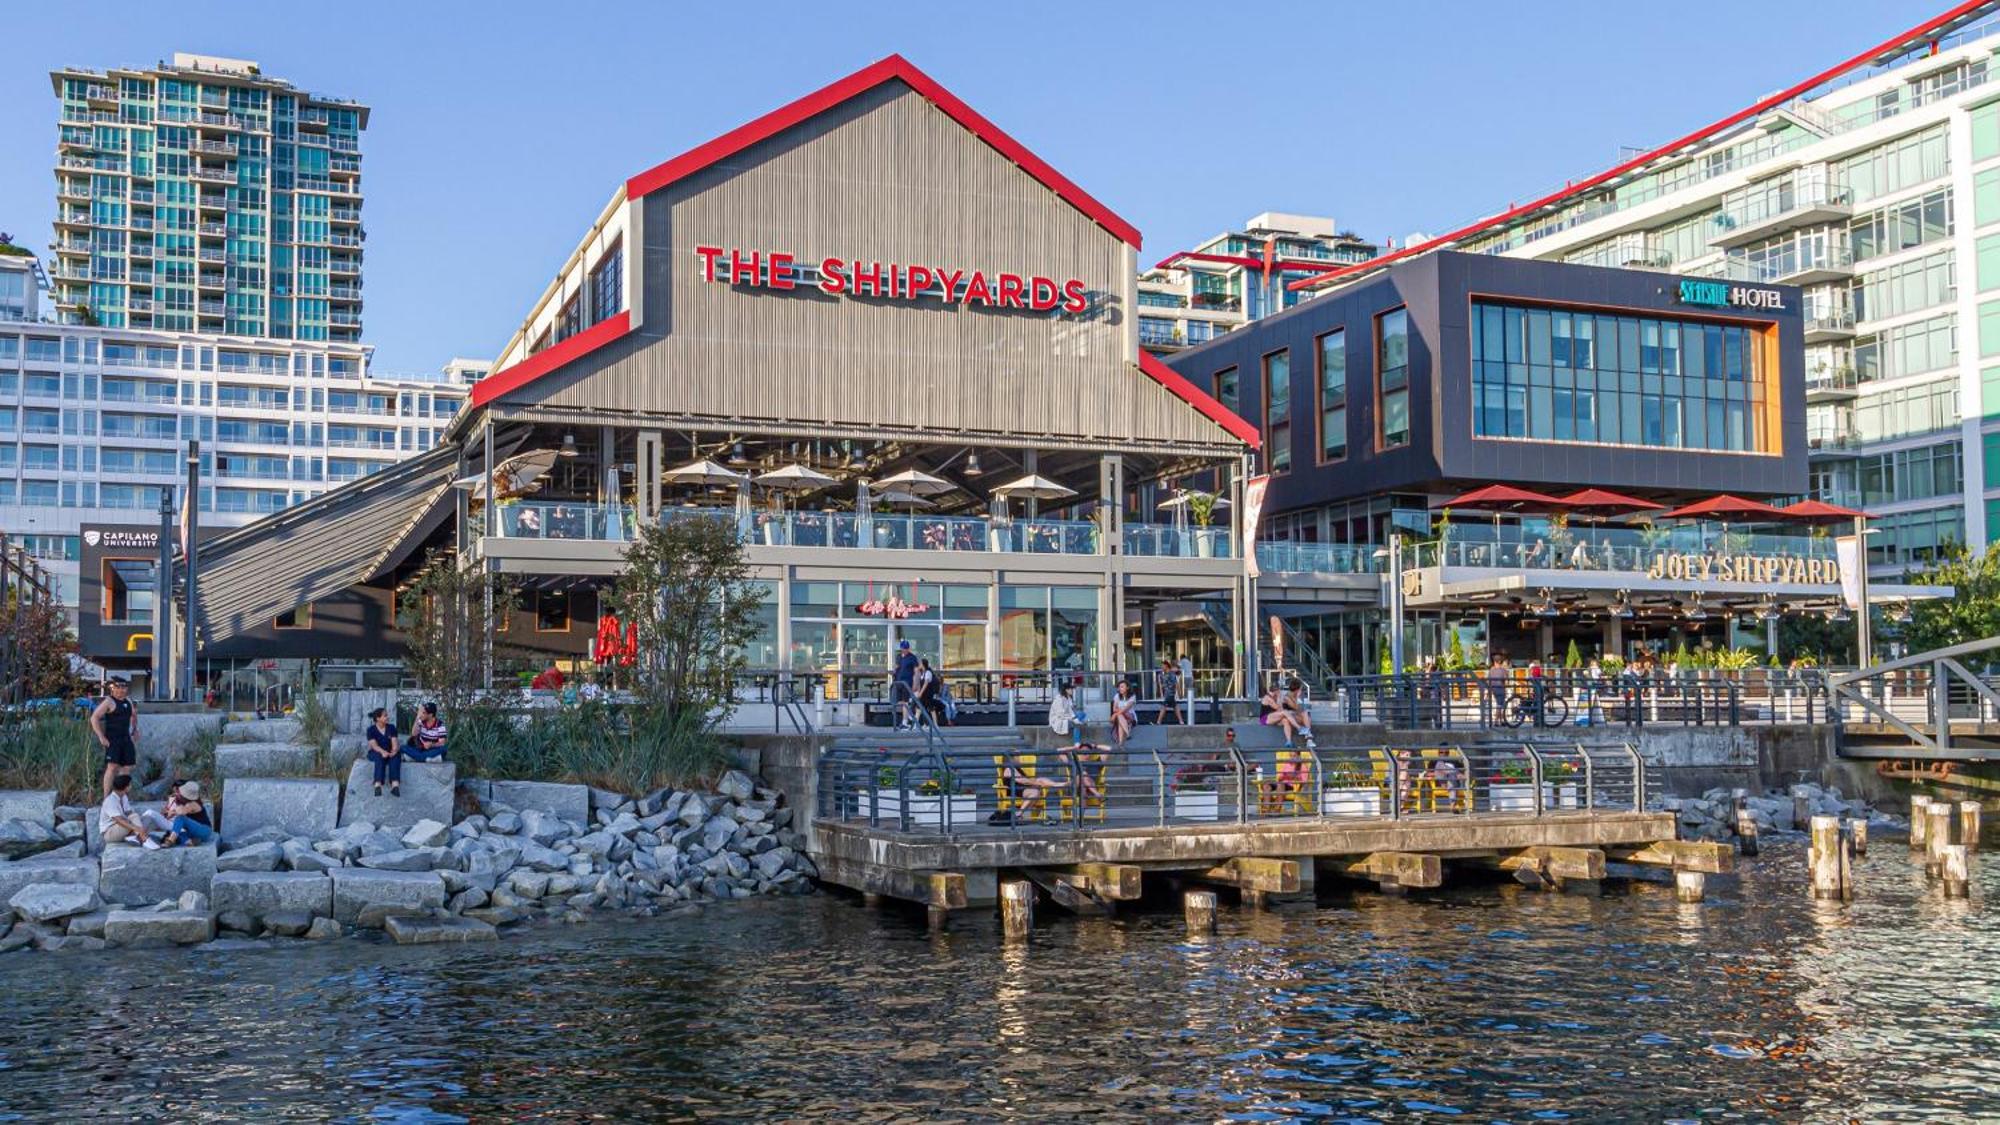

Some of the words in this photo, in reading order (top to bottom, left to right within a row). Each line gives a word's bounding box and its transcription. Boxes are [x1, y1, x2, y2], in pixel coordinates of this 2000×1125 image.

[696, 246, 795, 290] THE
[819, 257, 1088, 313] SHIPYARDS
[1732, 287, 1786, 309] HOTEL
[103, 532, 158, 541] CAPILANO
[1647, 554, 1712, 581] JOEY
[1719, 555, 1837, 585] SHIPYARD
